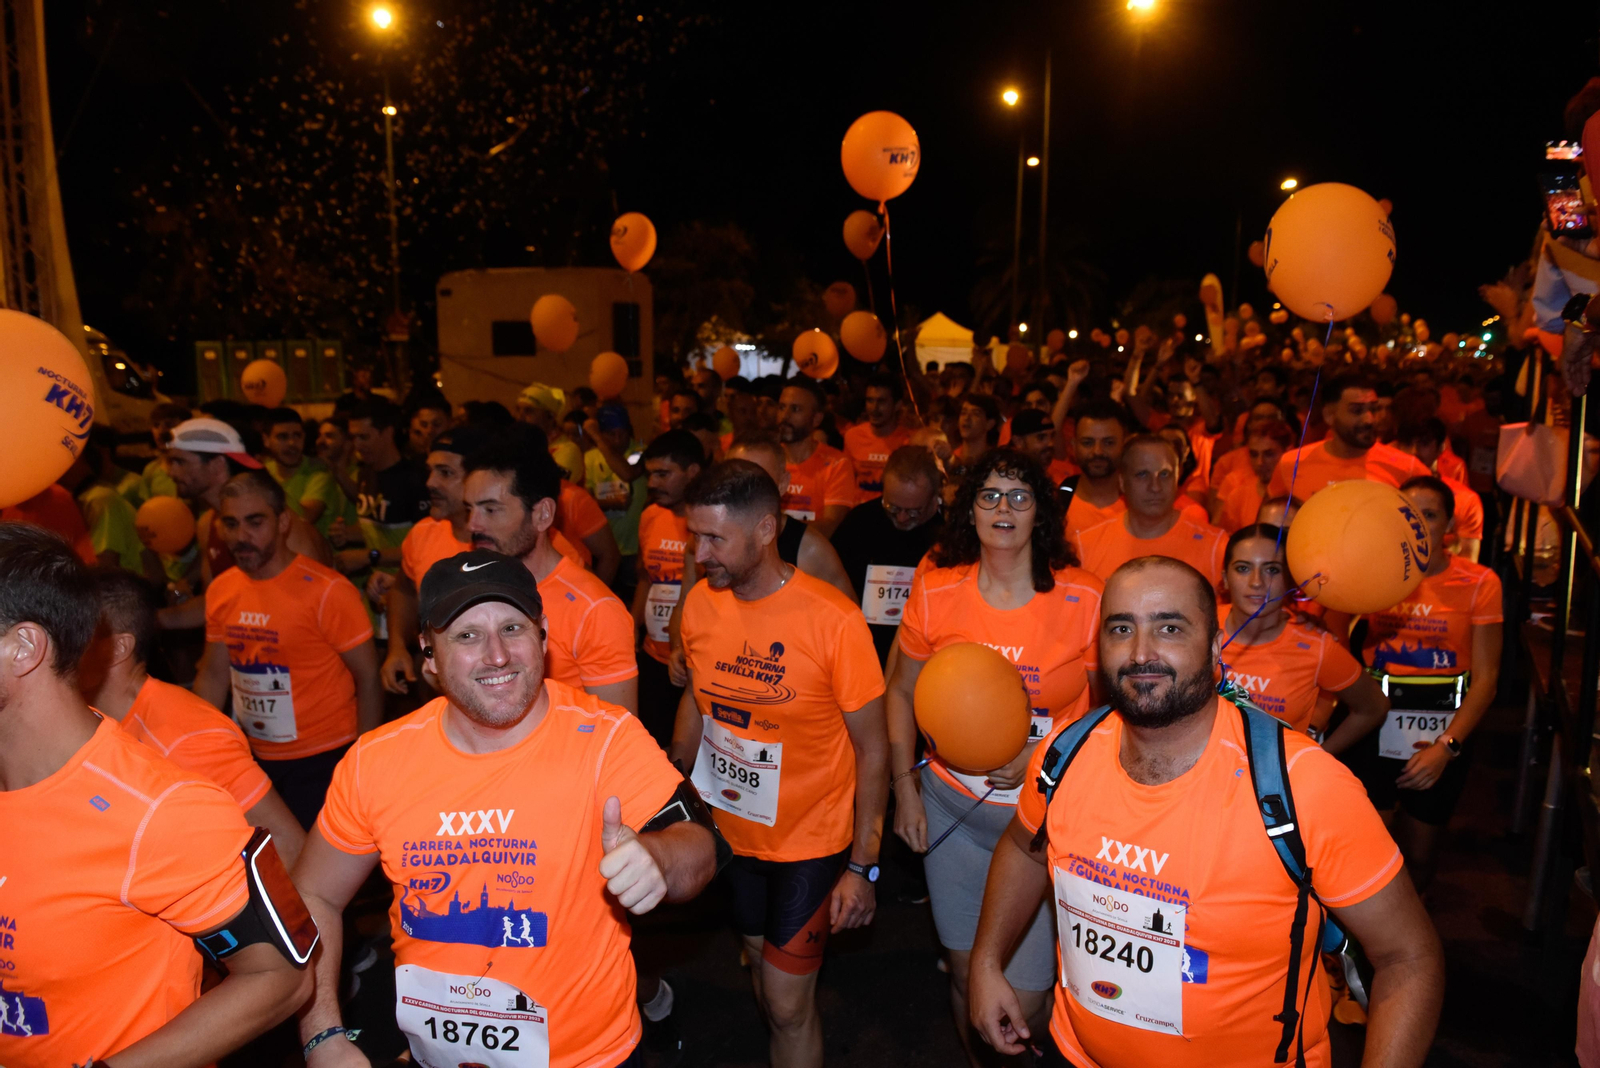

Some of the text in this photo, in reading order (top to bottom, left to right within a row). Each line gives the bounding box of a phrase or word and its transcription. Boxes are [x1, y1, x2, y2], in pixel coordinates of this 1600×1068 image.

[1401, 541, 1411, 582] SEVILLA
[878, 586, 910, 600] 9174
[652, 605, 675, 617] 127
[715, 661, 755, 679] SEVILLA
[736, 656, 786, 674] NOCTURNA
[241, 695, 276, 713] 12117
[1396, 715, 1447, 731] 17031
[711, 753, 760, 788] 13598
[436, 809, 515, 836] XXXV
[403, 838, 538, 851] CARRERA NOCTURNA
[410, 850, 537, 867] GUADALQUIVIR
[1096, 836, 1169, 875] XXXV
[1123, 872, 1190, 899] NOCTURNA
[1072, 923, 1154, 973] 18240
[1135, 1014, 1175, 1028] Cruzcampo
[425, 1017, 519, 1051] 18762
